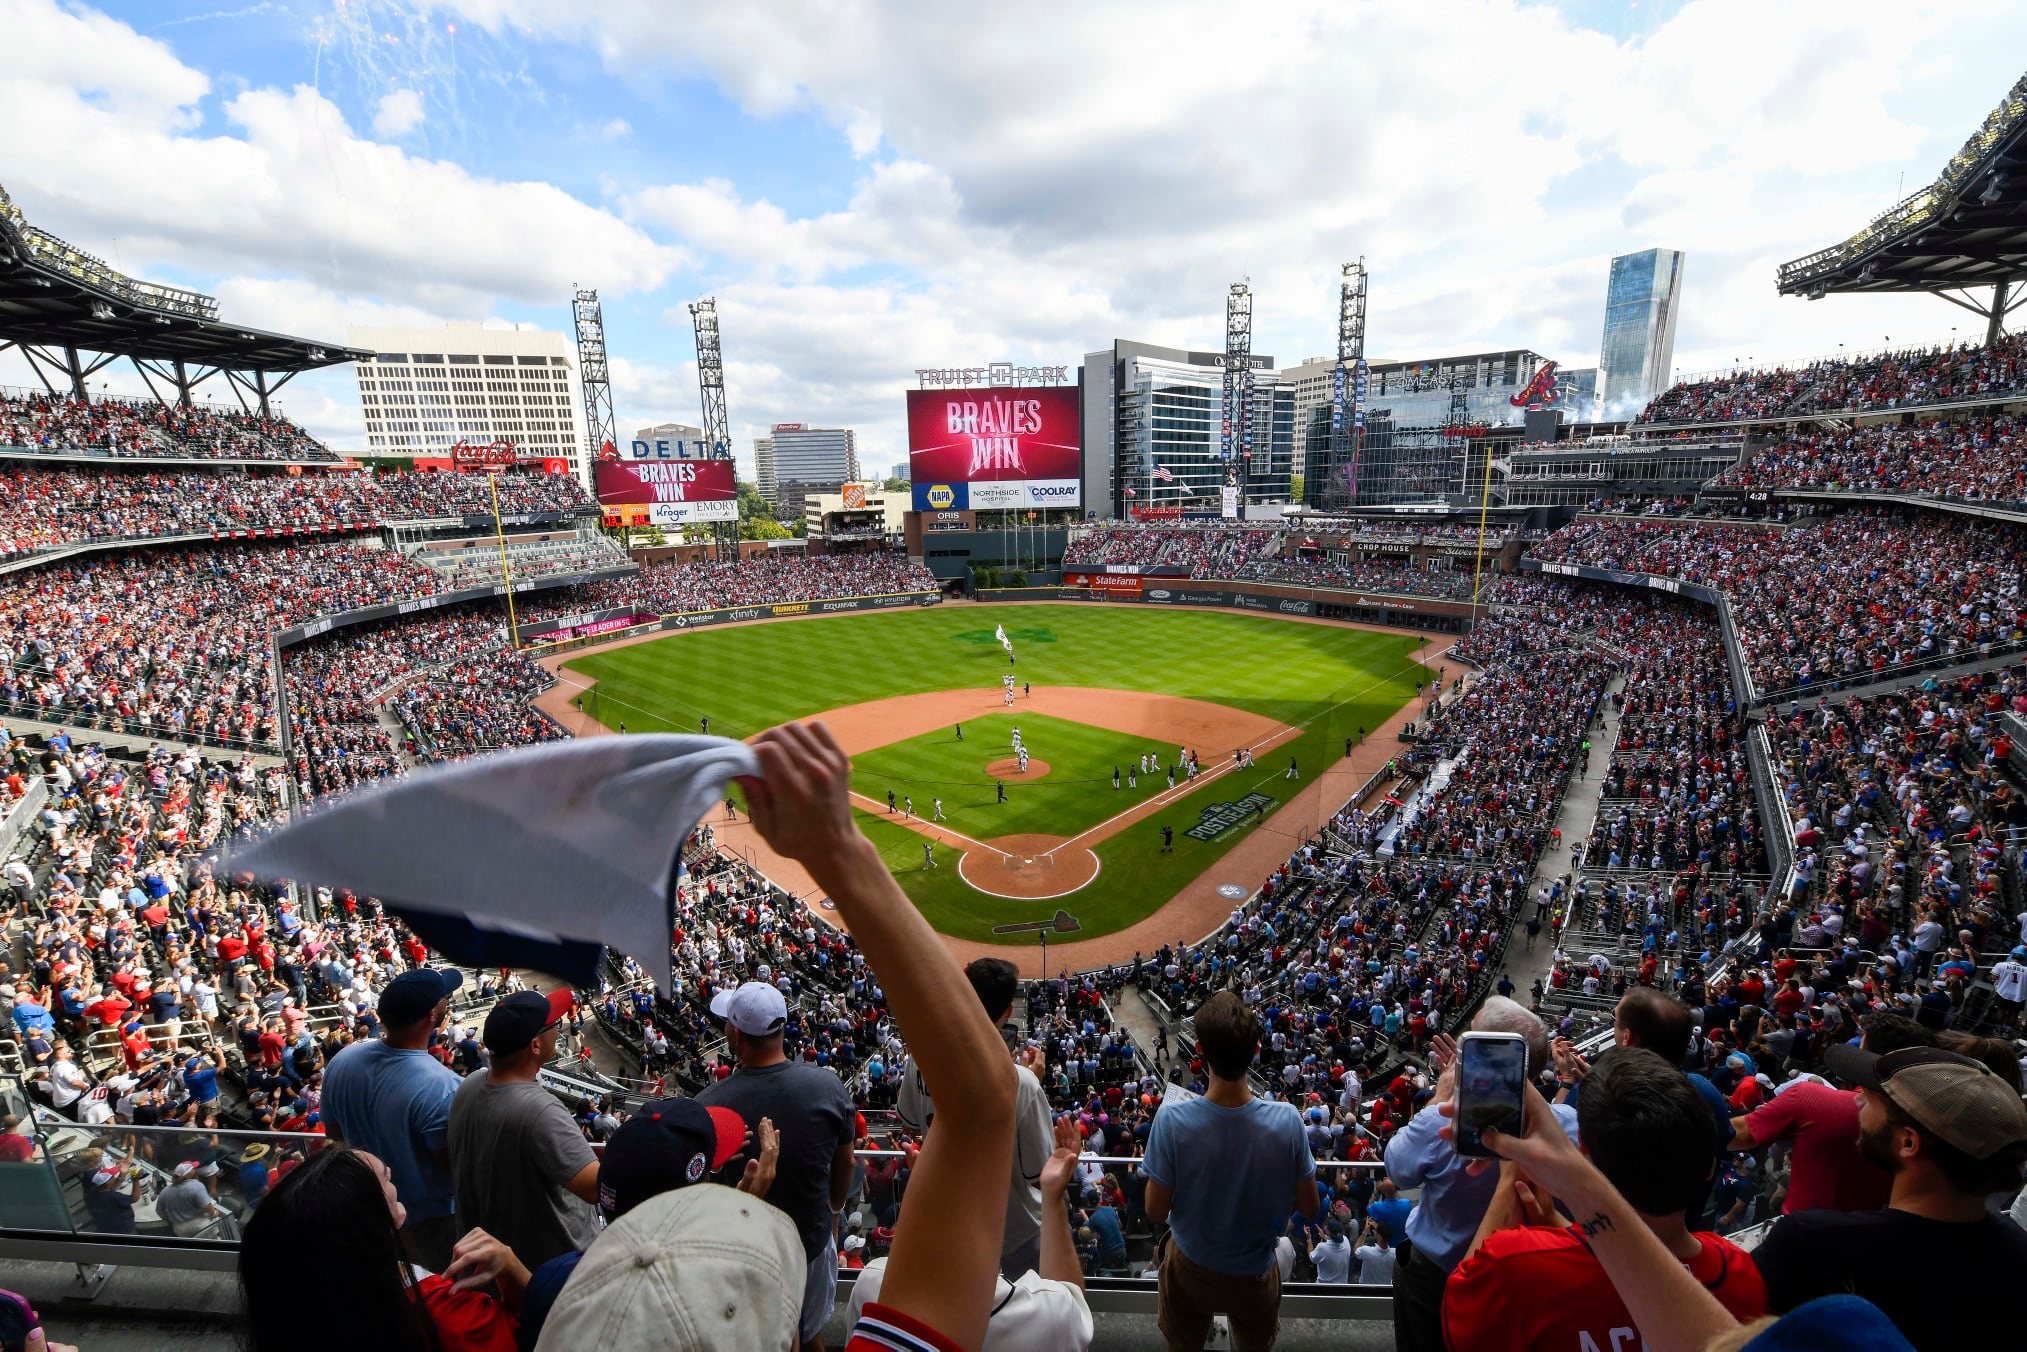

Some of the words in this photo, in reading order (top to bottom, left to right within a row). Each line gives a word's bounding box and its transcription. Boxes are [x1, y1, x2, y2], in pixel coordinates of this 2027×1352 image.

[915, 368, 985, 385] TRUIST
[1017, 366, 1068, 382] PARK
[1387, 373, 1456, 388] COMCAST
[947, 400, 1042, 434] BRAVES
[632, 440, 730, 459] DELTA
[971, 437, 1020, 469] WIN
[639, 463, 696, 482] BRAVES
[655, 483, 685, 501] WIN
[932, 491, 951, 502] NAPA
[1032, 487, 1077, 496] COOLRAY
[1749, 492, 1767, 500] 4:28
[656, 504, 688, 521] Kroger
[697, 501, 735, 512] EMORY
[937, 511, 960, 520] ORIS
[1358, 543, 1380, 551] CHOP
[1381, 544, 1410, 552] HOUSE
[1106, 565, 1127, 574] BRAVES
[1128, 566, 1139, 574] WIN
[772, 604, 810, 613] QUIKRETE
[823, 601, 858, 611] EQUIFAX
[558, 617, 582, 629] BRAVES
[583, 614, 594, 624] WIN
[729, 609, 760, 621] xfinity
[591, 622, 613, 633] LEADER
[614, 620, 621, 629] IN
[1187, 793, 1271, 840] POSTSEASON
[91, 1087, 107, 1101] 10
